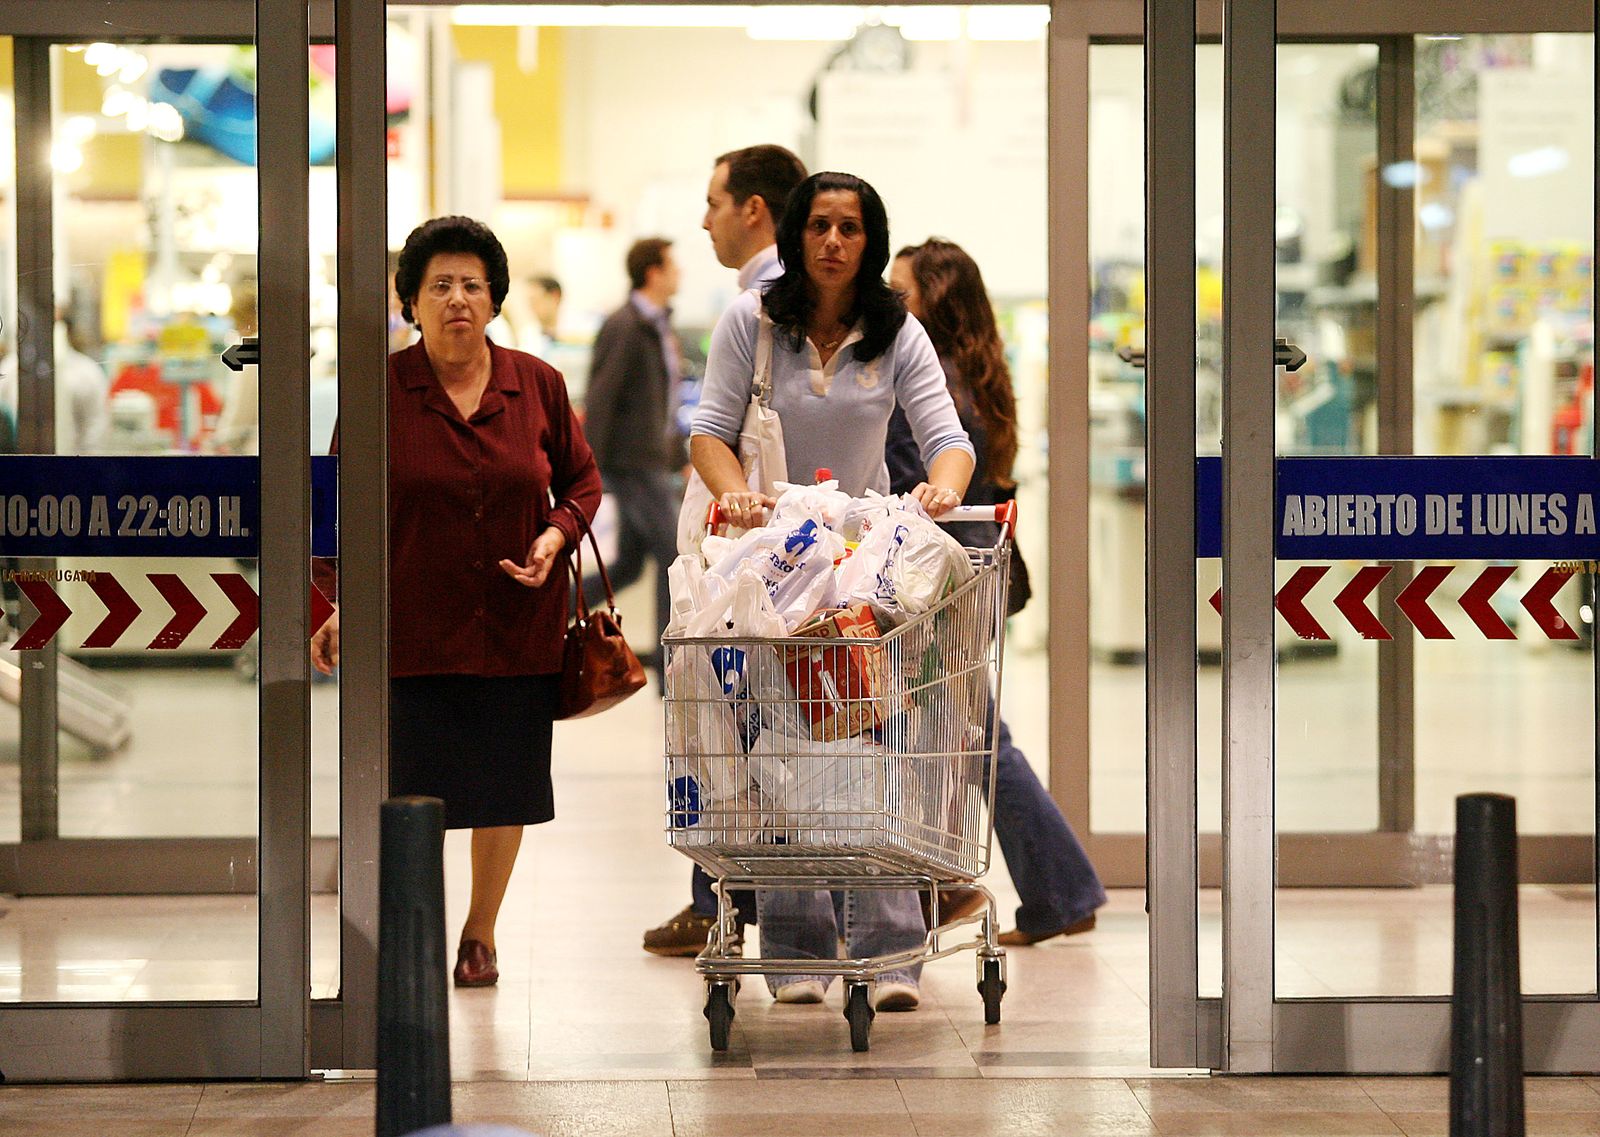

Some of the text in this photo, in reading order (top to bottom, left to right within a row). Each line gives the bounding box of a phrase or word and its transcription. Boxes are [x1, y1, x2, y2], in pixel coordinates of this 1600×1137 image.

[88, 495, 111, 536] A
[117, 494, 211, 537] 22:00
[219, 496, 249, 536] H.
[1282, 493, 1597, 536] ABIERTO DE LUNES A
[20, 568, 97, 582] MADRUGADA
[1552, 561, 1586, 575] ZONA
